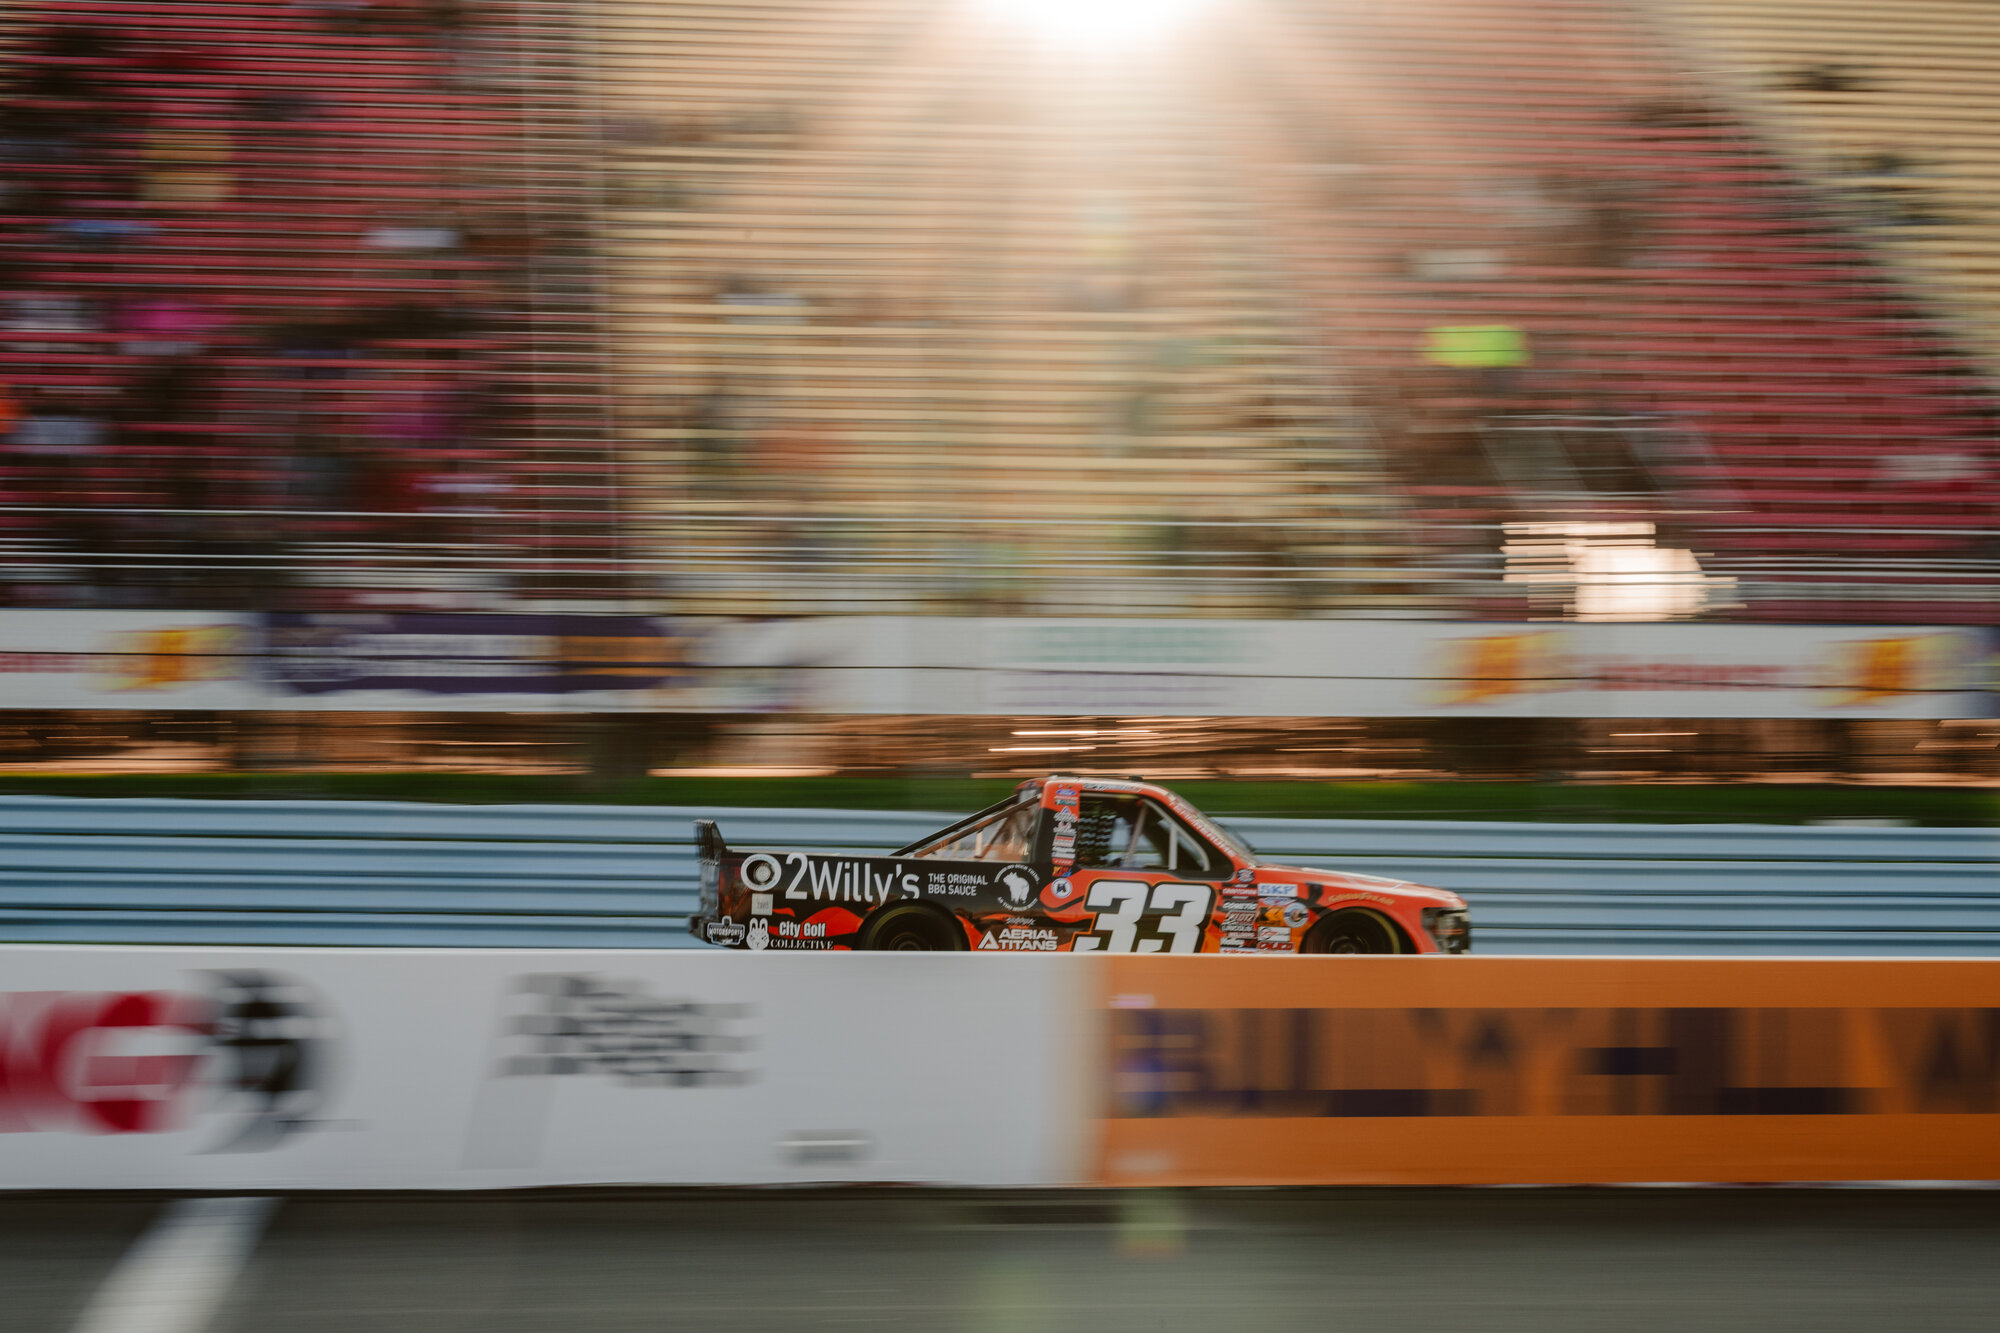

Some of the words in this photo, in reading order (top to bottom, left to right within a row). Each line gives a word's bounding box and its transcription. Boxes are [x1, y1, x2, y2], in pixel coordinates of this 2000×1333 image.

[928, 873, 946, 883] THE
[947, 874, 988, 885] ORIGINAL
[928, 884, 946, 895] BBQ
[948, 885, 977, 896] SAUCE
[1073, 881, 1212, 953] 33
[779, 921, 800, 938] City
[803, 922, 826, 938] Golf
[998, 928, 1058, 940] AERIAL
[770, 938, 834, 950] COLLECTIVE
[998, 939, 1058, 950] TITANS
